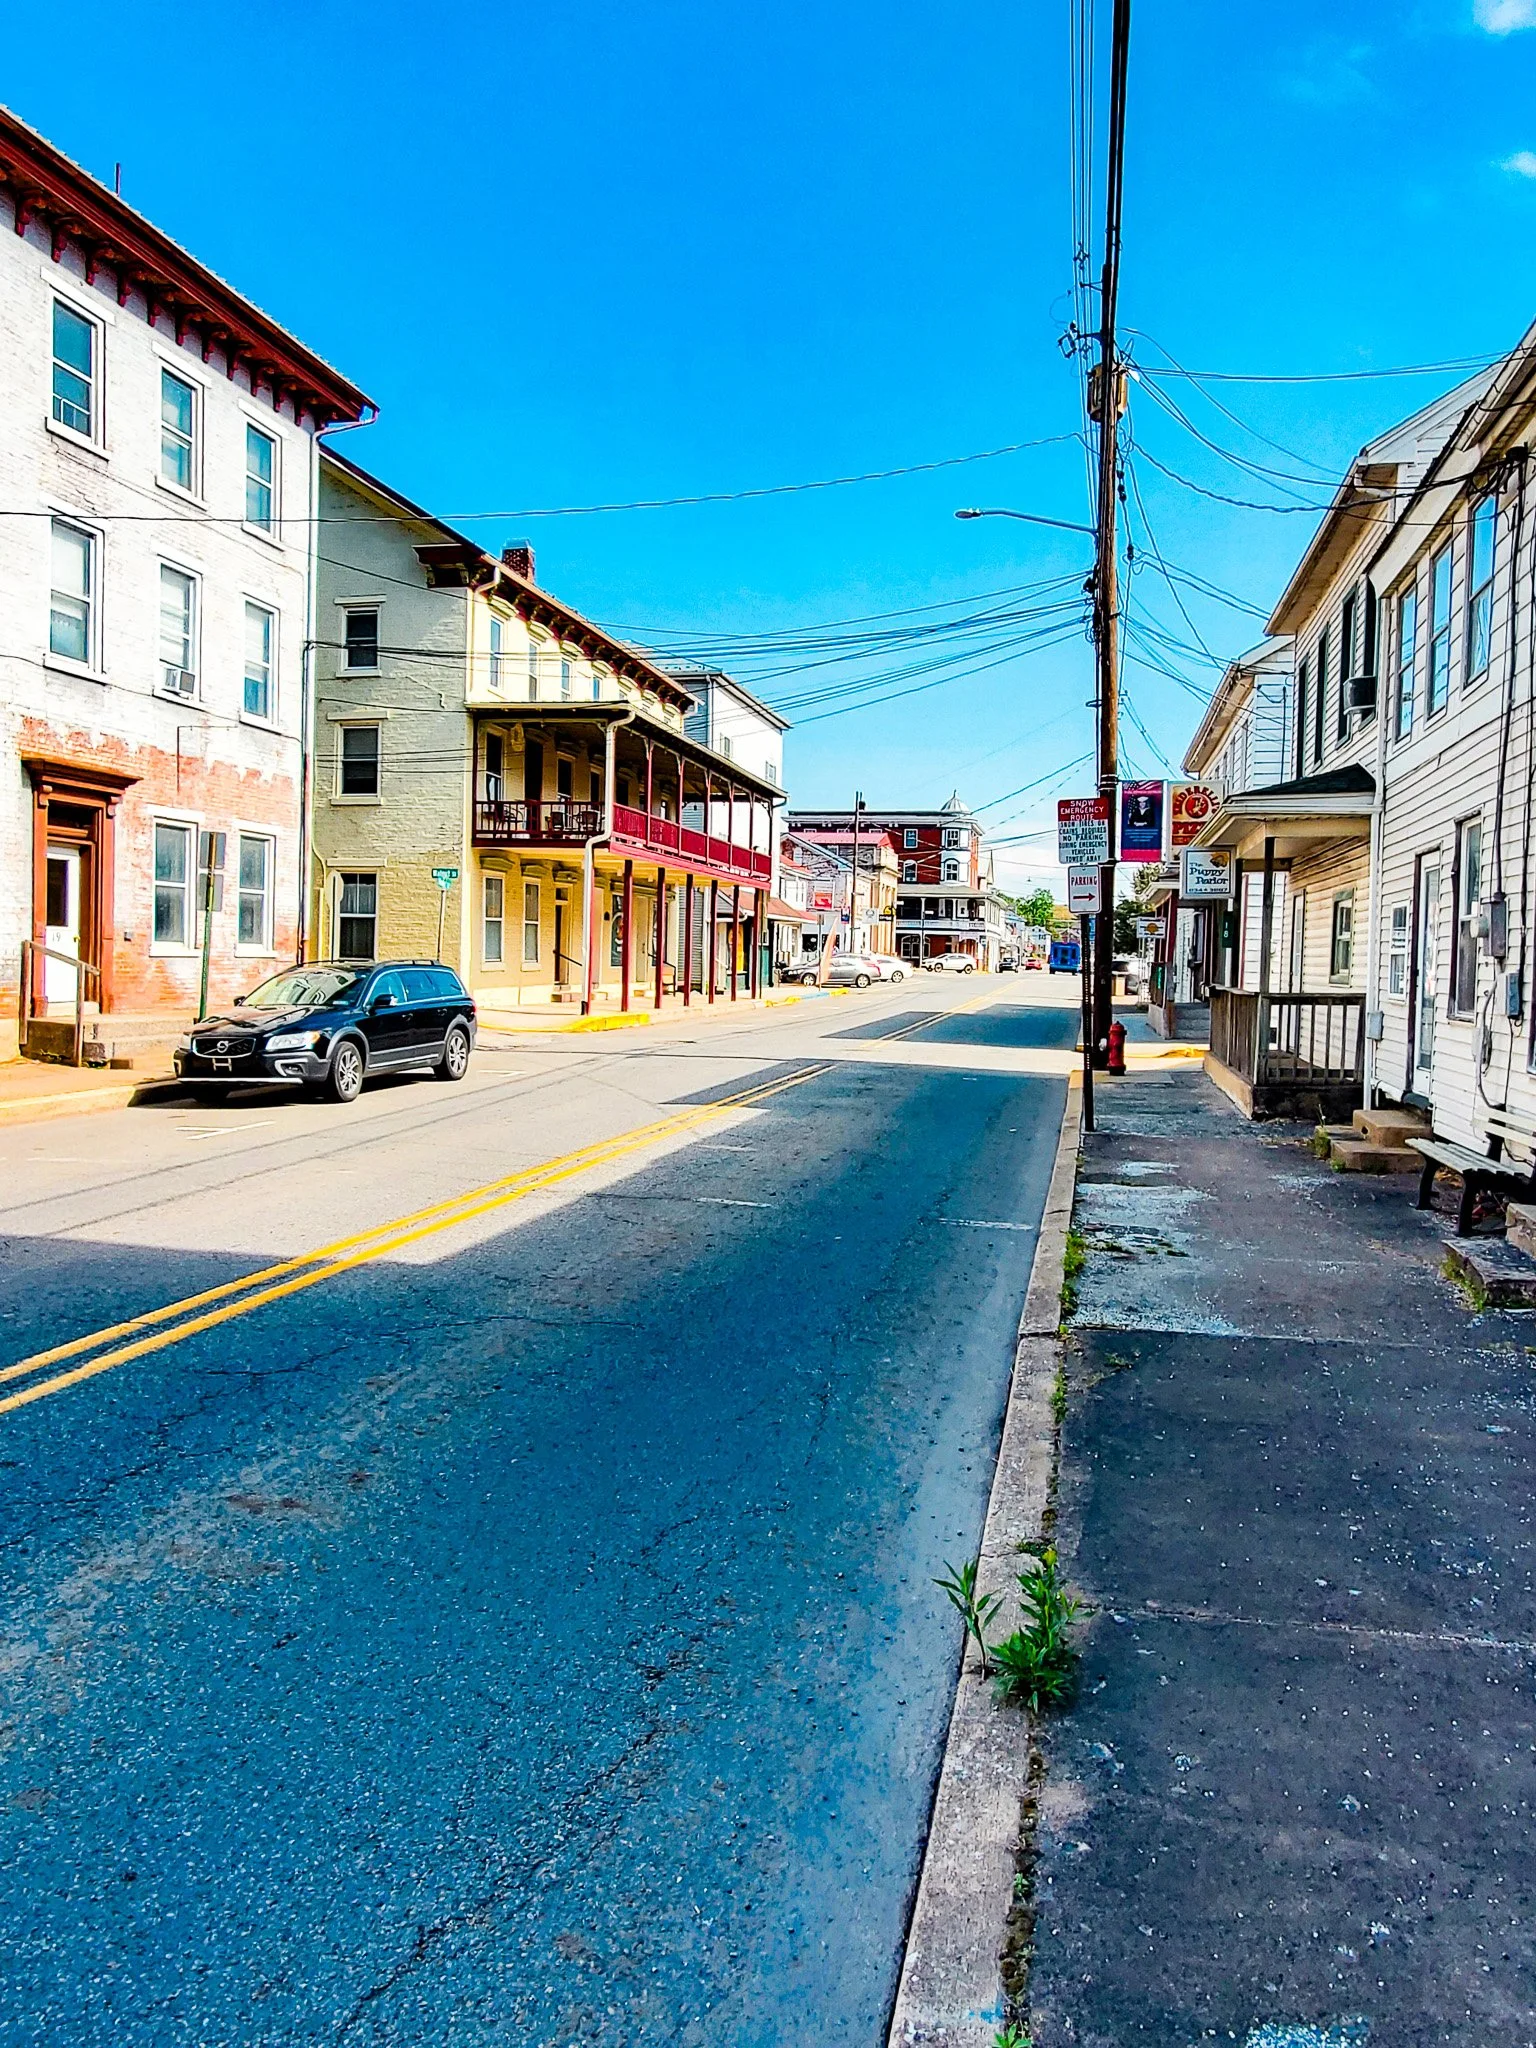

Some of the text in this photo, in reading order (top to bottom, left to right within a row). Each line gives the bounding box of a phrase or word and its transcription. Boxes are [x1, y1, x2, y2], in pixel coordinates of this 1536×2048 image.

[1060, 806, 1104, 814] EMERGENCY
[1059, 827, 1078, 835] CHAINS
[1071, 848, 1096, 856] VEHICLES
[1189, 867, 1226, 877] Puppy
[1070, 875, 1098, 886] PARKING
[1195, 876, 1229, 884] Parlor
[52, 931, 61, 942] 19
